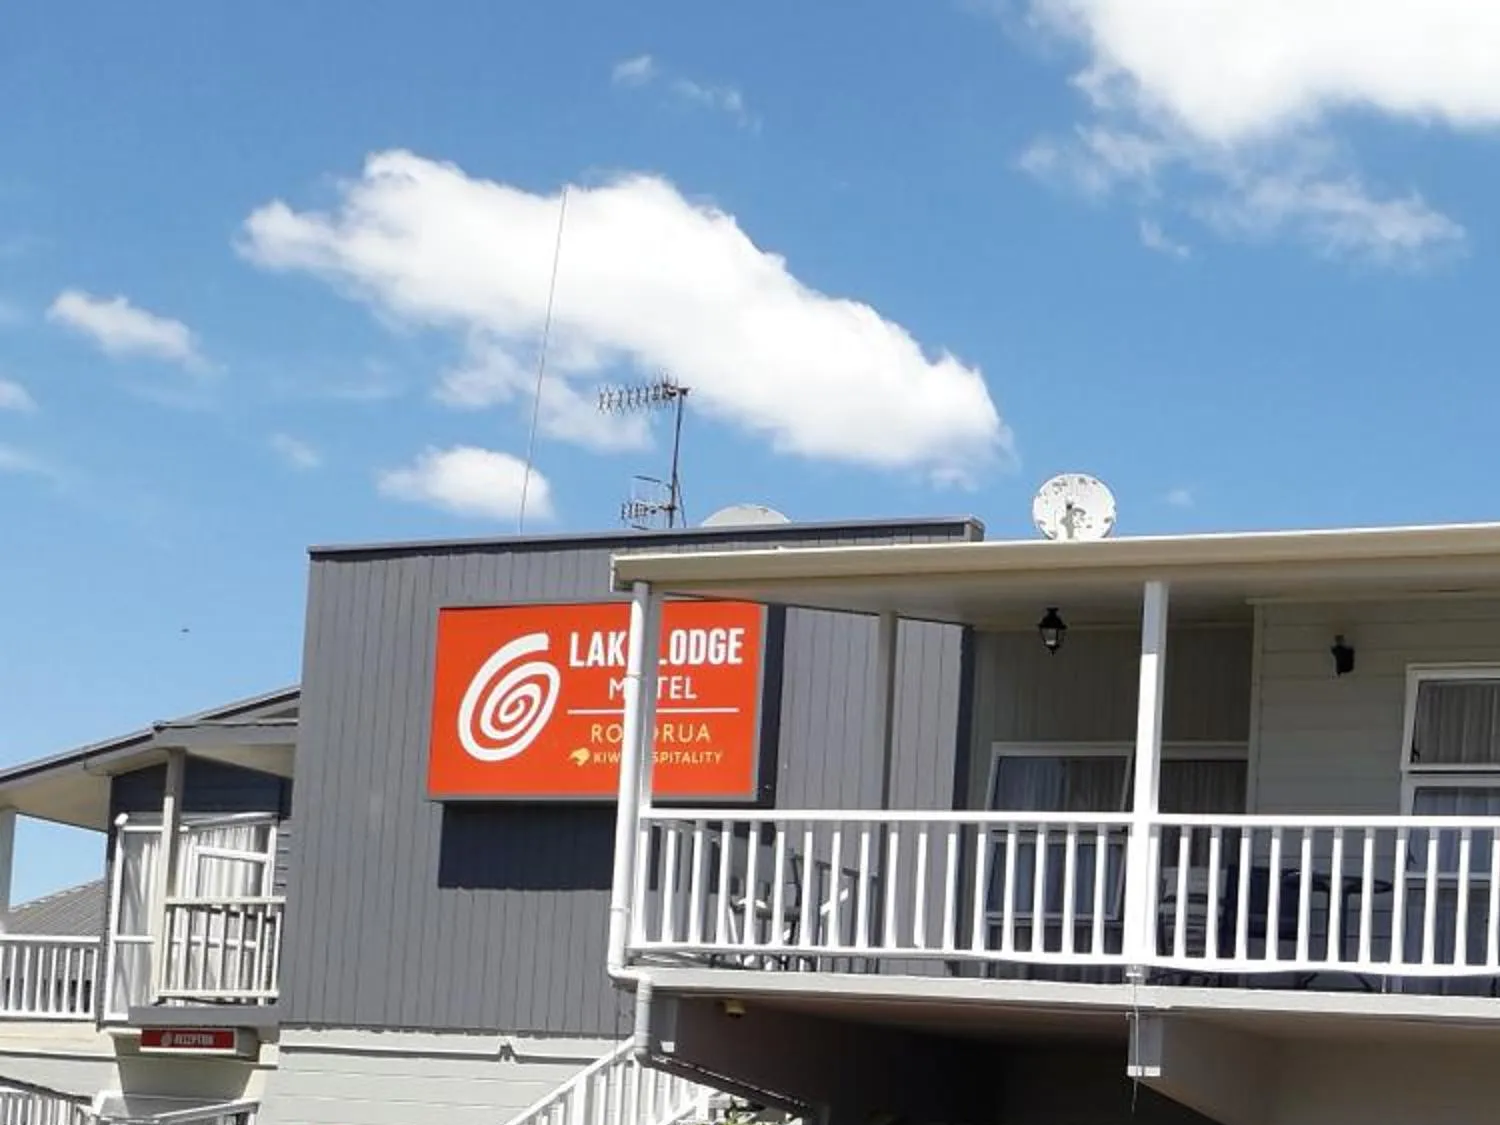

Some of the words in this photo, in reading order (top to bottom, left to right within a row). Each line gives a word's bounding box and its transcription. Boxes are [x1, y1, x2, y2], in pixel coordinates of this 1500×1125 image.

[568, 630, 629, 668] LAK
[608, 675, 698, 701] MTEL
[590, 722, 712, 744] RORUA
[593, 752, 623, 765] KIW
[651, 750, 724, 765] SPITALITY
